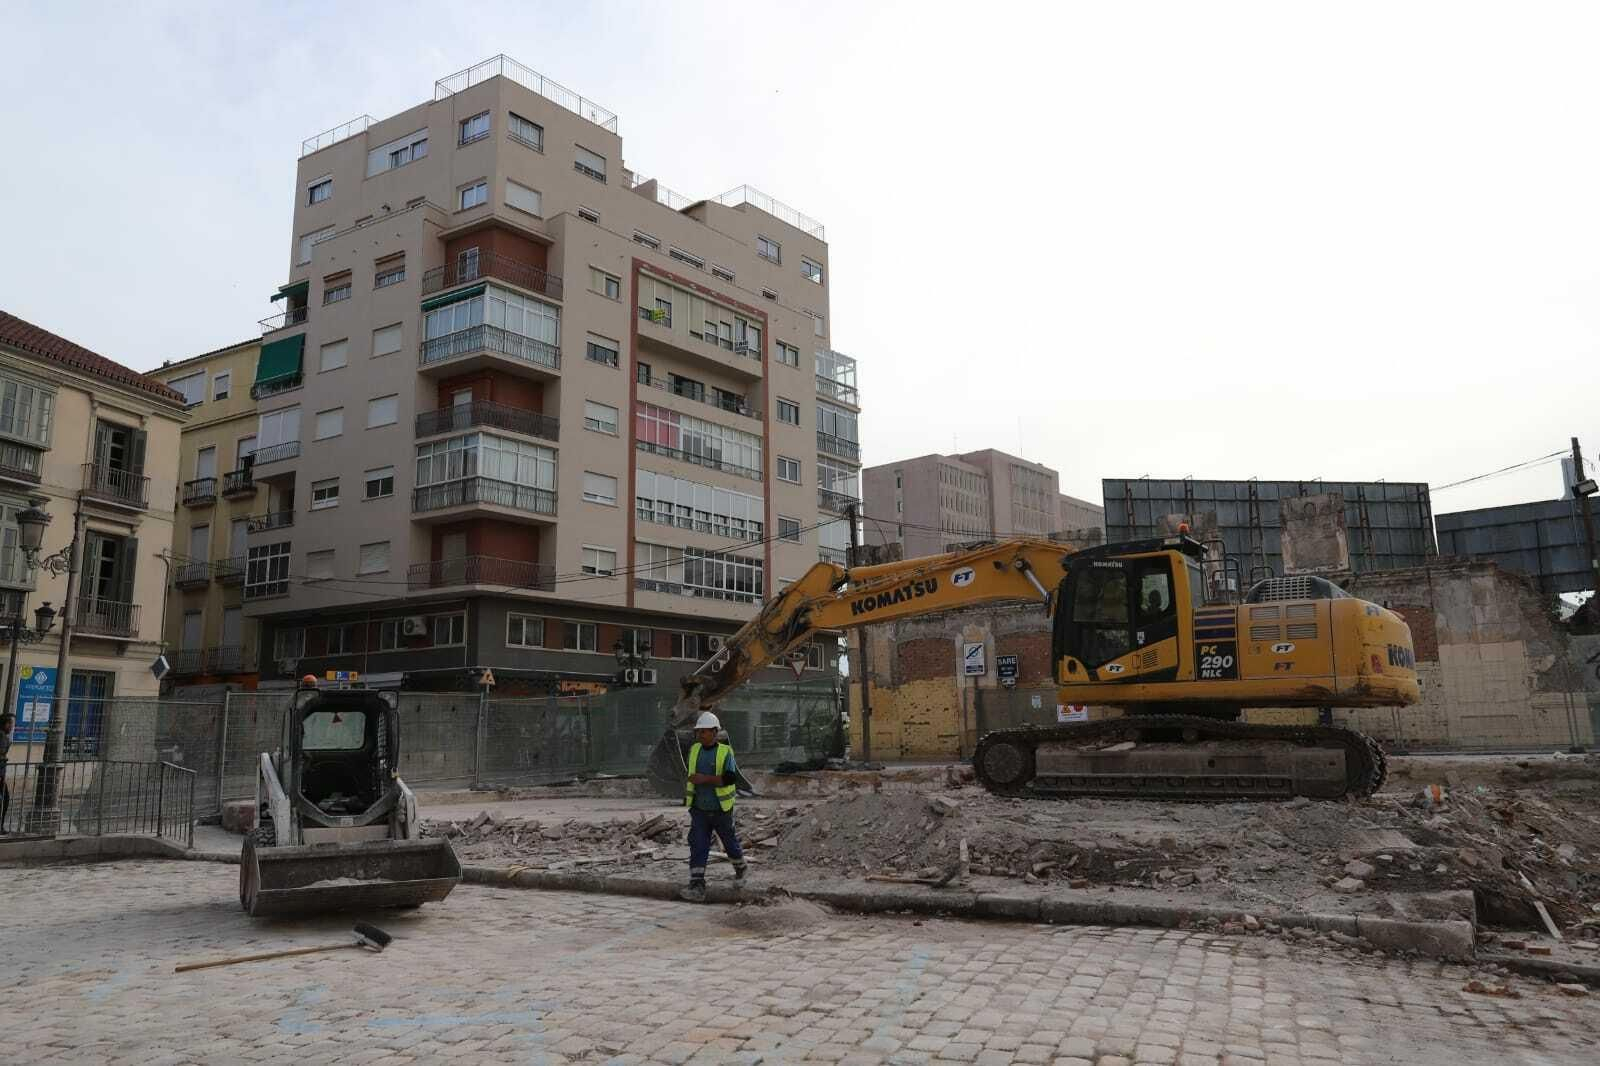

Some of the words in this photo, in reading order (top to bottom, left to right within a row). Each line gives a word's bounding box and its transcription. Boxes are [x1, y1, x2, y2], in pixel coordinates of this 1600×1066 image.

[851, 578, 938, 615] KOMATSU
[1200, 645, 1218, 655] PC
[1275, 644, 1292, 652] FT
[1200, 655, 1234, 669] 290
